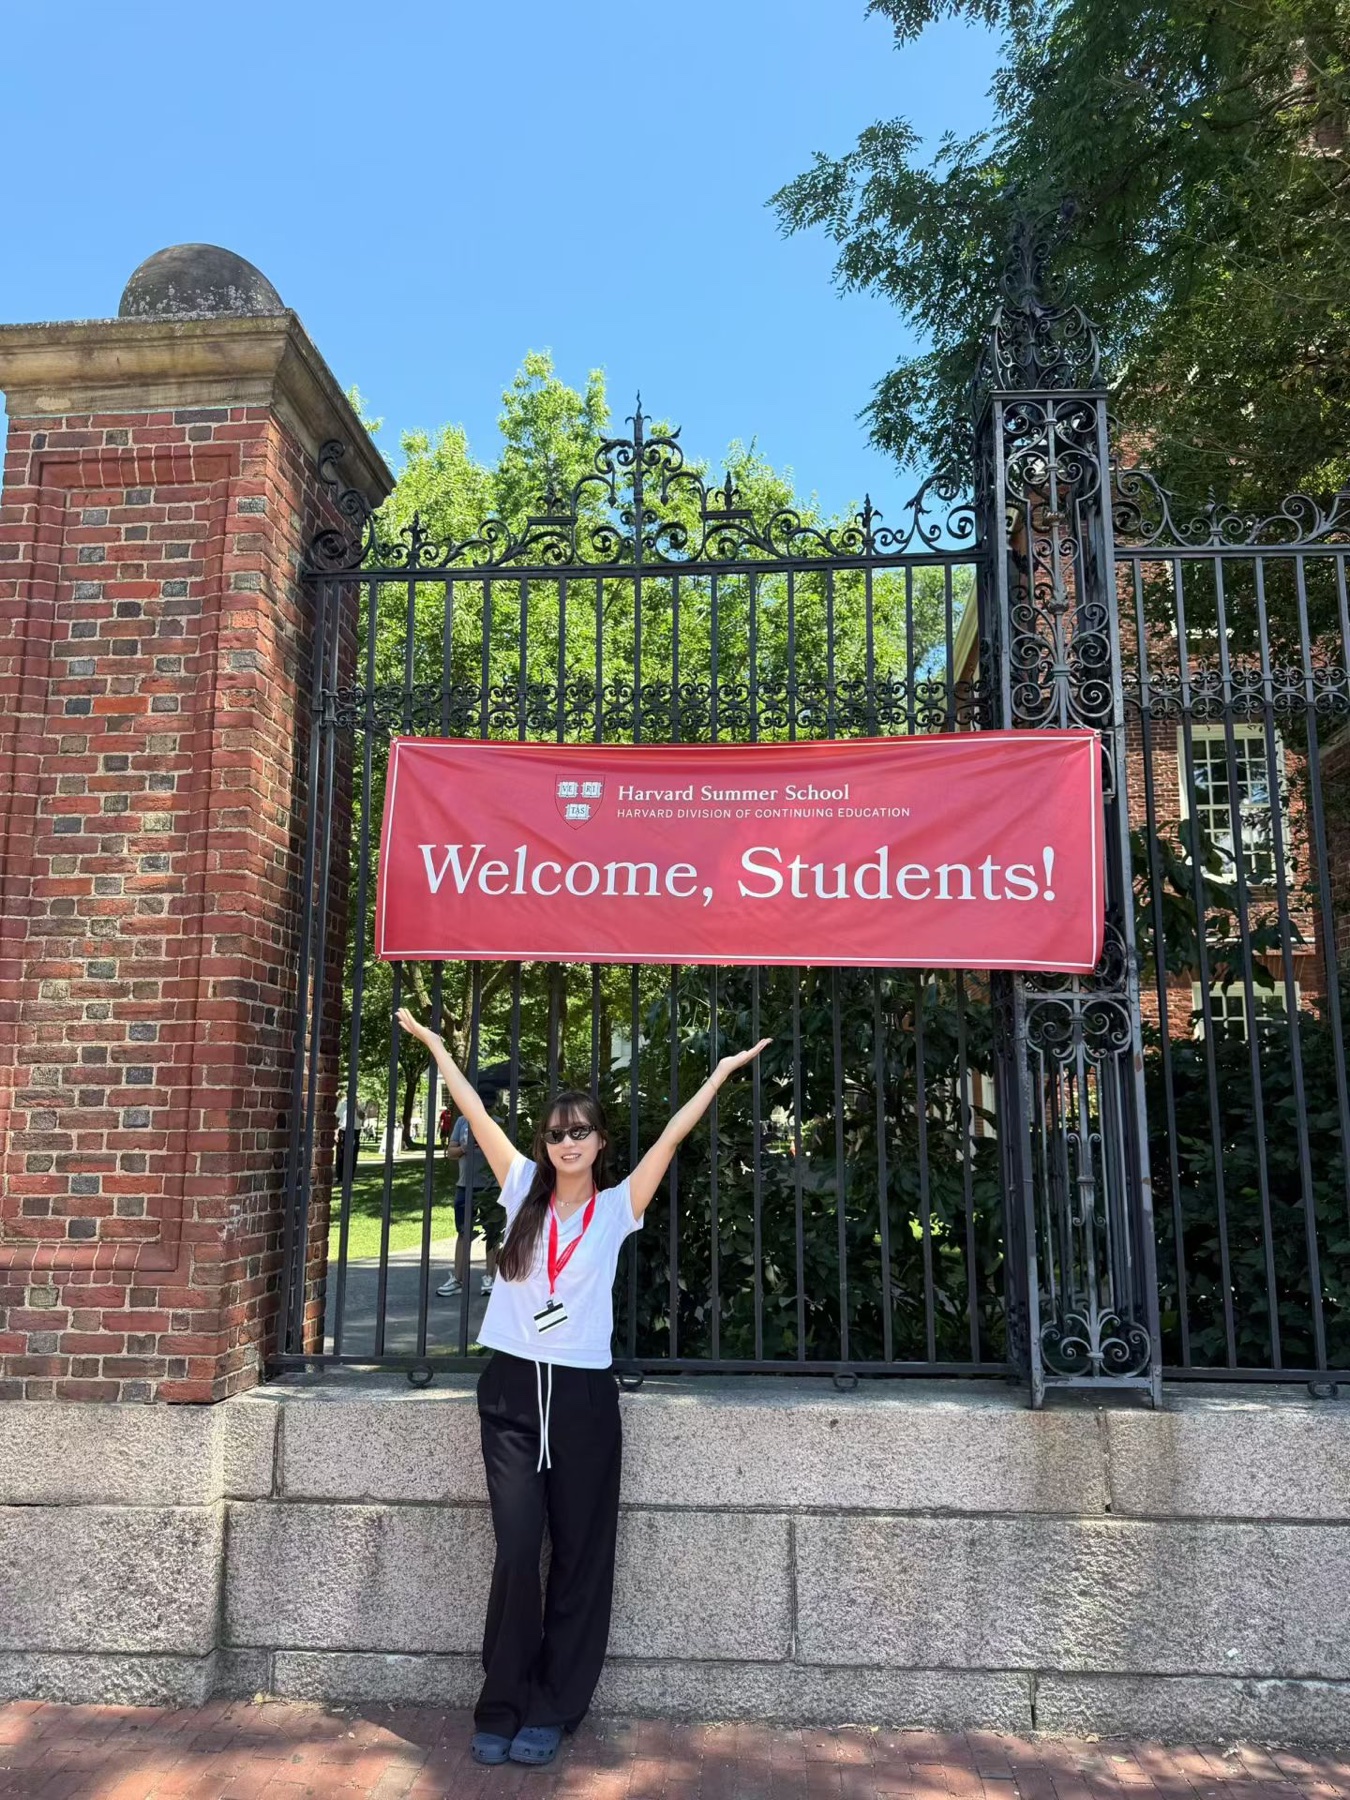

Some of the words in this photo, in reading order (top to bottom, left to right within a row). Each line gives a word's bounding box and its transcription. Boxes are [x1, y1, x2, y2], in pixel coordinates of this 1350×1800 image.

[618, 784, 694, 801] Harvard
[701, 785, 778, 801] Summer
[785, 783, 849, 801] School
[617, 808, 674, 819] HARVARD
[677, 808, 731, 819] DIVISION
[735, 808, 752, 819] OF
[754, 807, 833, 819] CONTINUING
[837, 807, 910, 818] EDUCATION
[418, 843, 713, 907] Welcome,
[737, 845, 1056, 902] Students!
